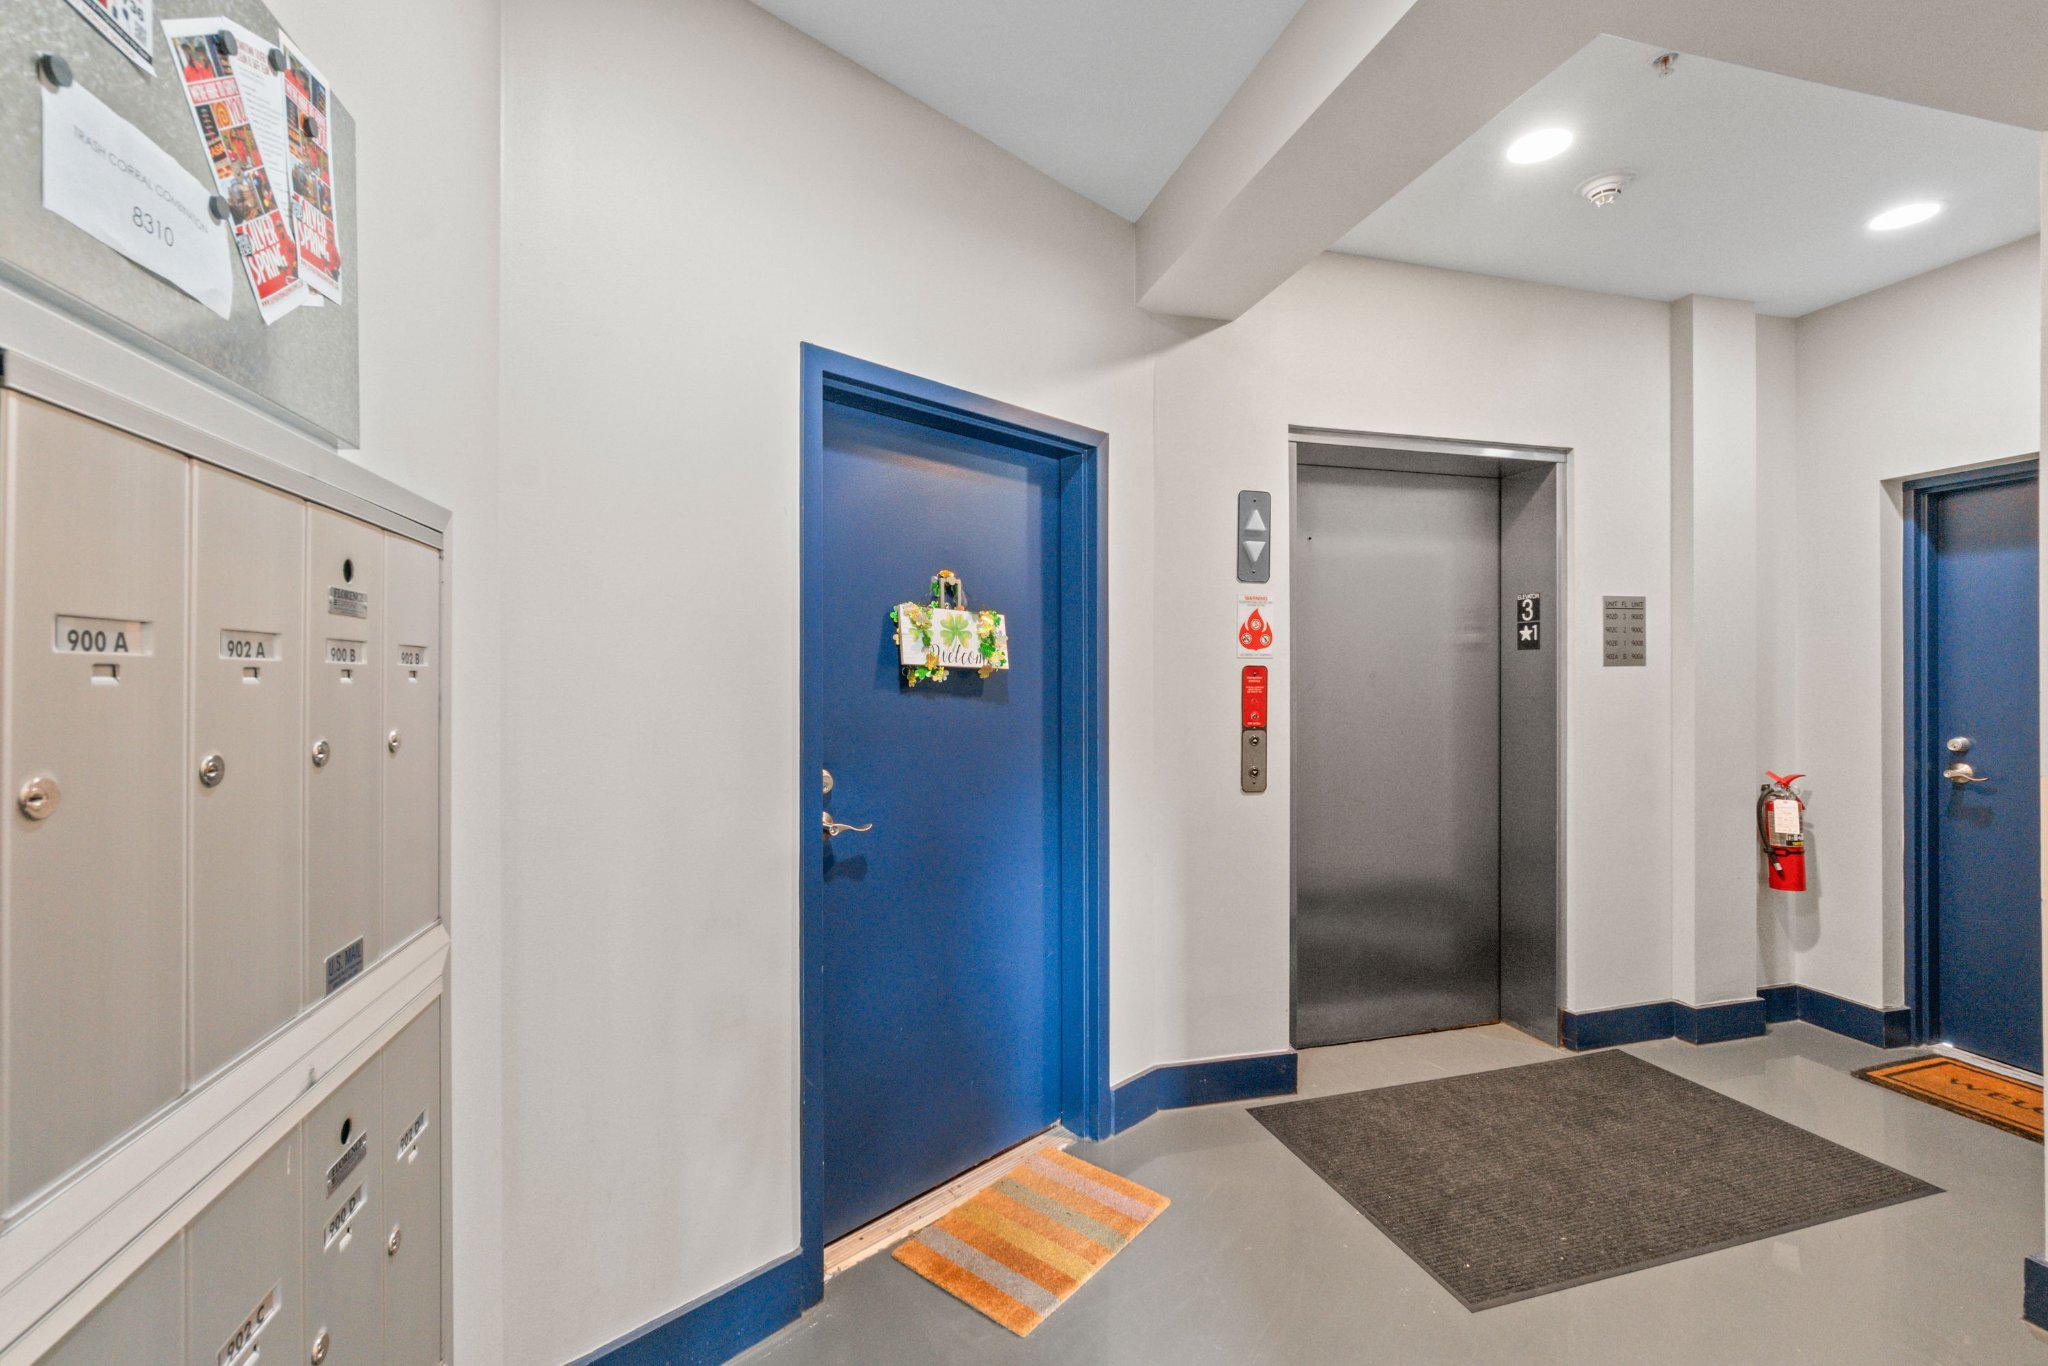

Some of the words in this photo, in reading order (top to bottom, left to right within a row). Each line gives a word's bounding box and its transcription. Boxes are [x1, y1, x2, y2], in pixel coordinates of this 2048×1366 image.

[132, 206, 174, 247] 8310
[243, 212, 281, 253] SILVER
[248, 243, 288, 286] SPRING
[1521, 599, 1533, 621] 3
[67, 629, 106, 652] 900
[114, 632, 128, 653] A
[1531, 624, 1538, 641] 1
[227, 640, 252, 658] 902
[256, 641, 266, 658] A
[331, 647, 347, 662] 900
[350, 648, 356, 662] B
[928, 643, 986, 665] Welcom
[227, 1320, 252, 1361] 902
[256, 1303, 266, 1325] C
